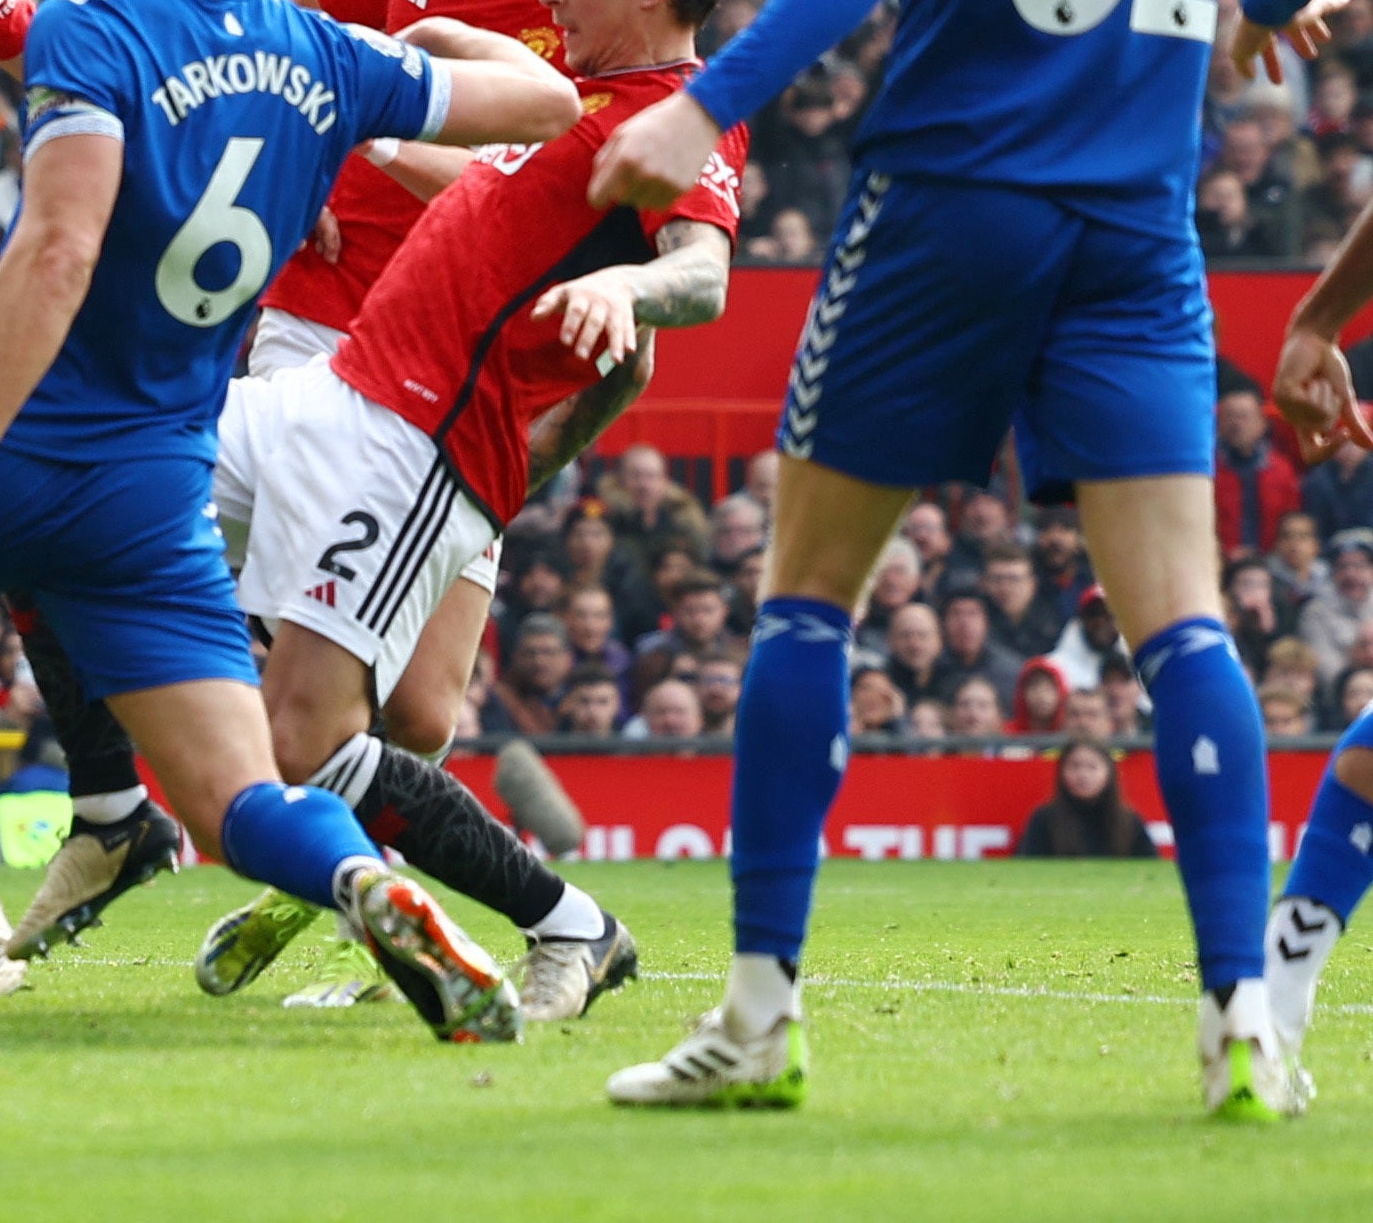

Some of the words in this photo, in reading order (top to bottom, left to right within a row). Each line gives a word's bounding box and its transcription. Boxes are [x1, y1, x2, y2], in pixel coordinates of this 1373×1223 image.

[152, 50, 337, 135] TARKOWSKI
[155, 137, 272, 328] 6
[317, 510, 379, 582] 2
